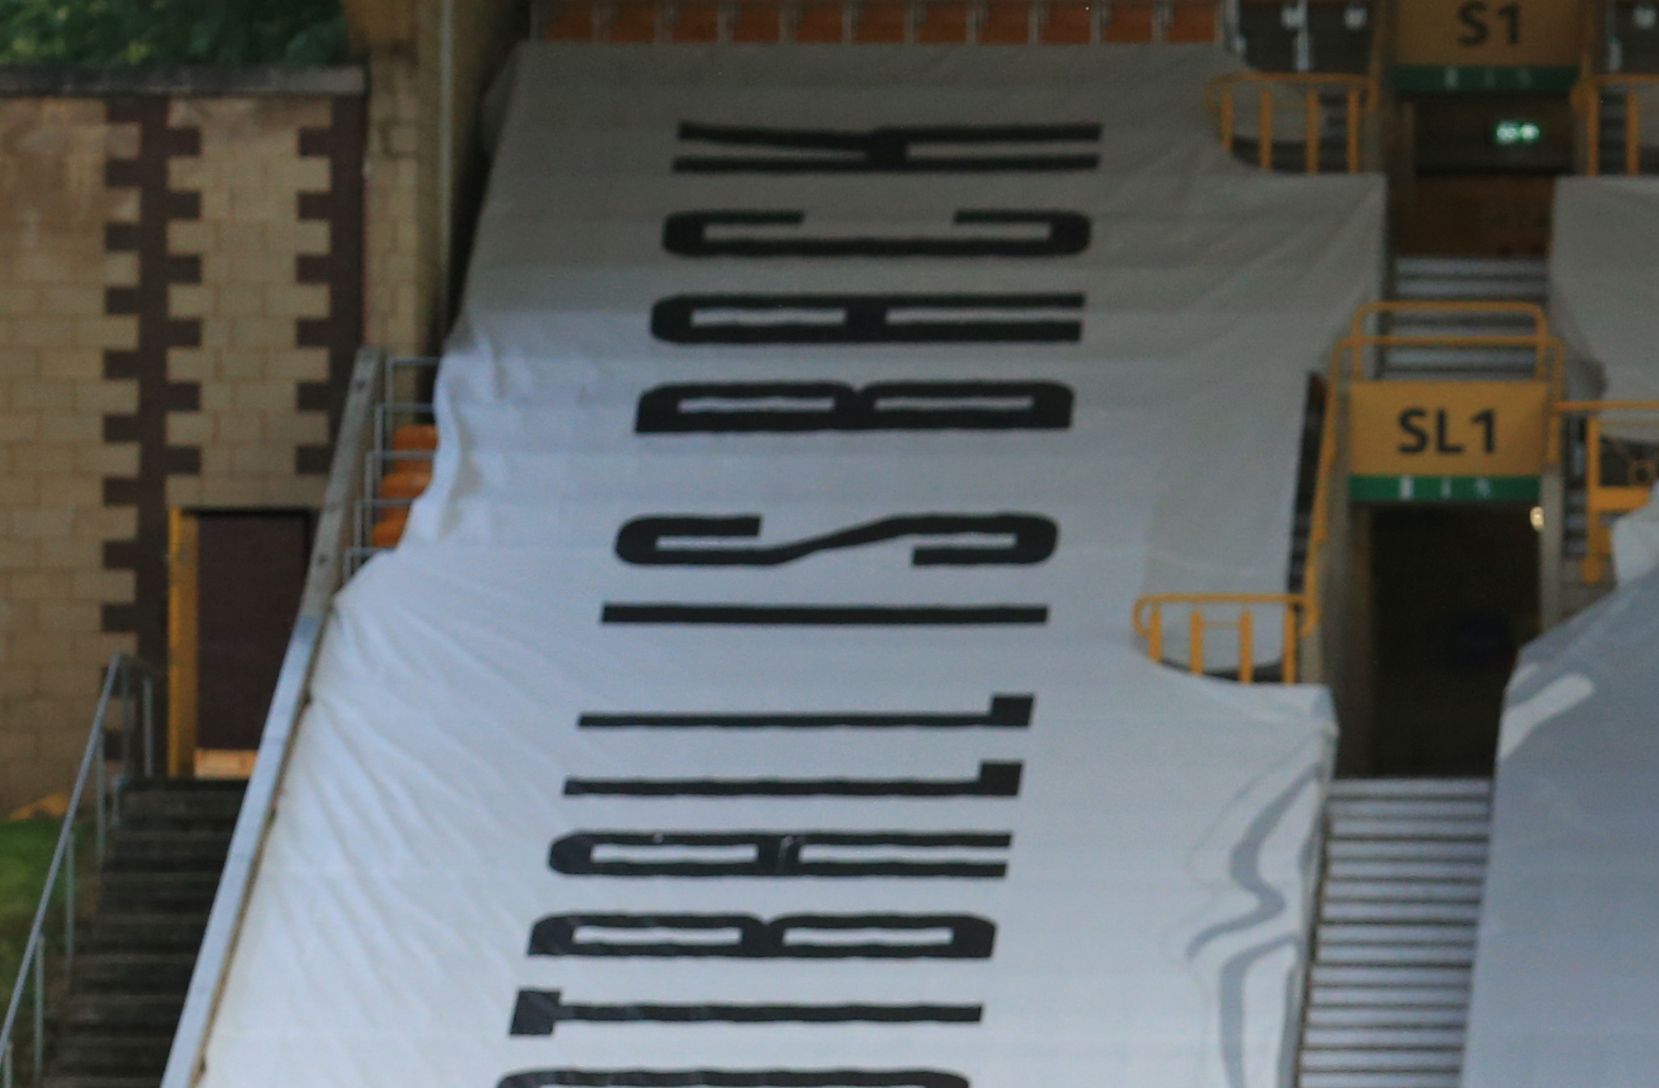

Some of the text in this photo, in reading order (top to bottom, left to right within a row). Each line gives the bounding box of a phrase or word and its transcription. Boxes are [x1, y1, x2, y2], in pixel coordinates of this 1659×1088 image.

[1456, 1, 1521, 47] S1
[633, 121, 1104, 435] BACK
[1398, 408, 1496, 455] SL1
[600, 513, 1059, 626] IS
